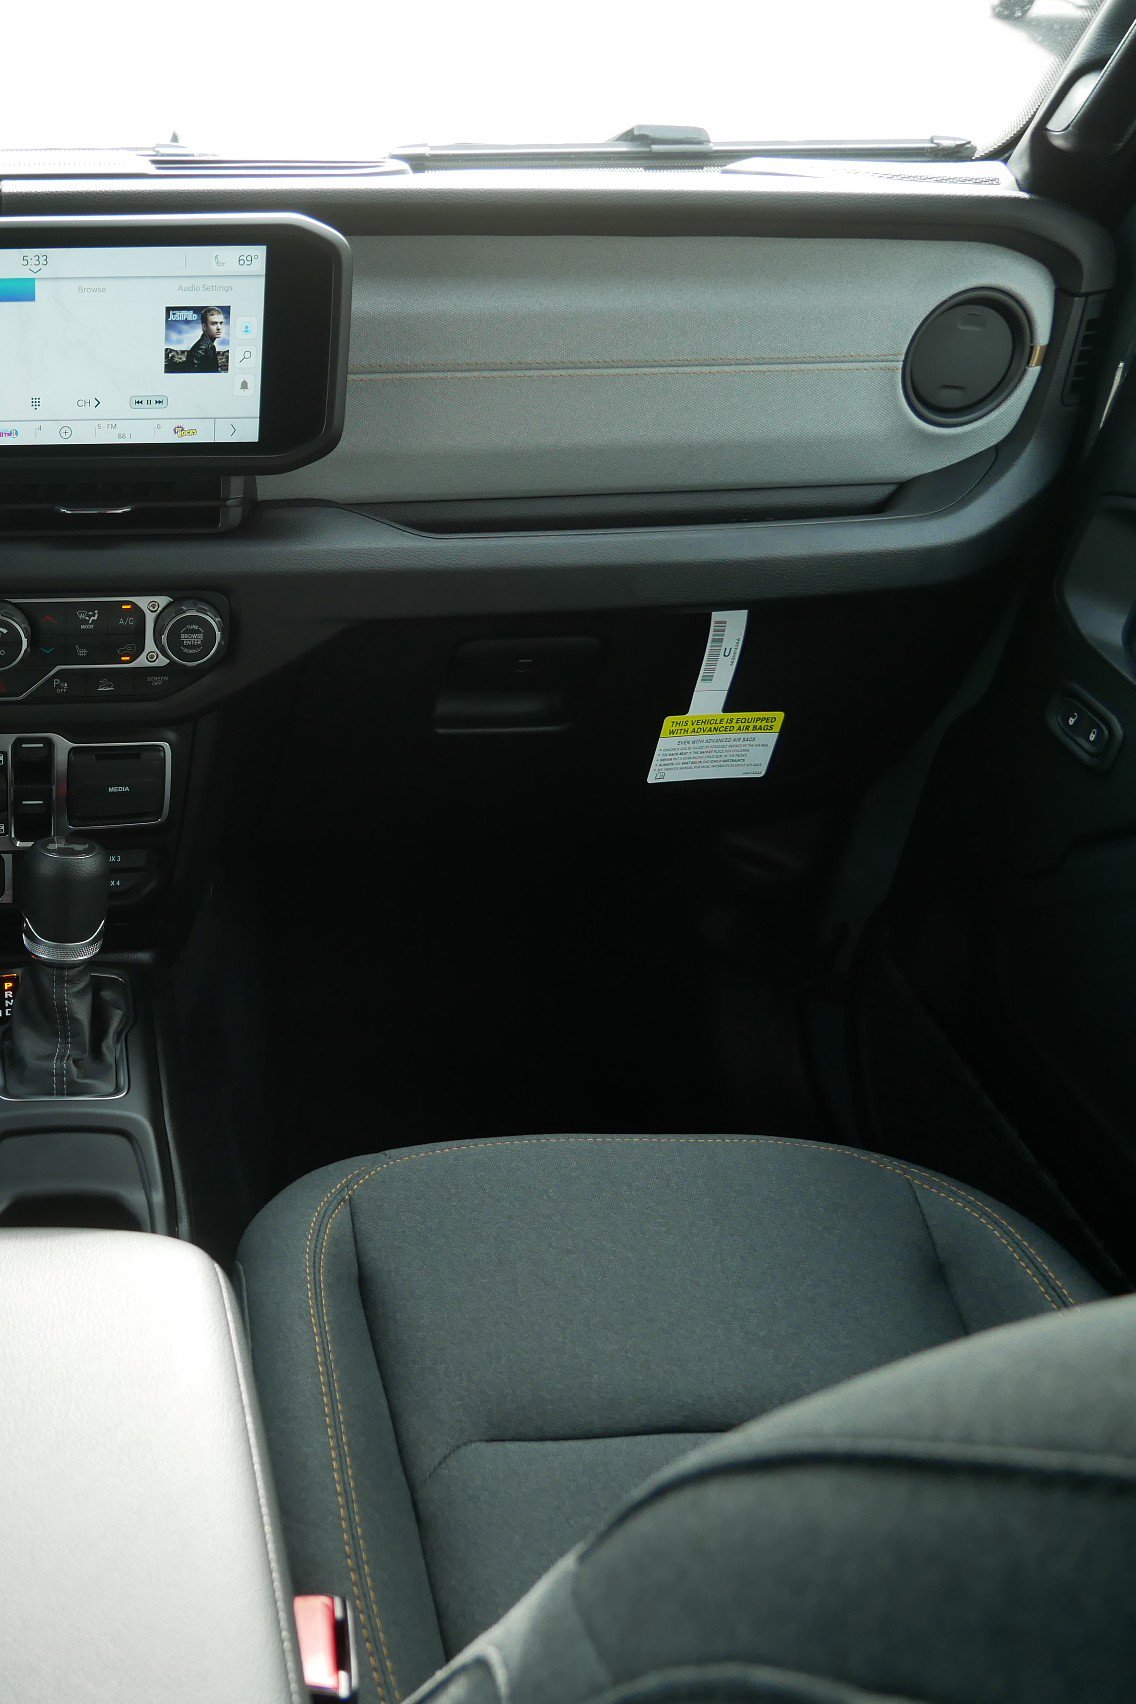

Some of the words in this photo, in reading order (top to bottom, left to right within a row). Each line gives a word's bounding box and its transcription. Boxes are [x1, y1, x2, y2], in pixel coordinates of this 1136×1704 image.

[21, 254, 48, 267] 5:33
[77, 285, 107, 294] Browse
[178, 283, 201, 292] Audio
[202, 283, 233, 293] Settings
[76, 399, 91, 408] CH
[118, 617, 134, 625] A/C
[723, 648, 732, 657] U
[670, 719, 689, 728] THIS
[690, 718, 724, 726] VEHICLE
[725, 717, 734, 725] IS
[735, 716, 777, 725] EQUIPPED
[690, 725, 734, 734] ADVANCED
[4, 982, 12, 990] P
[4, 991, 13, 999] R
